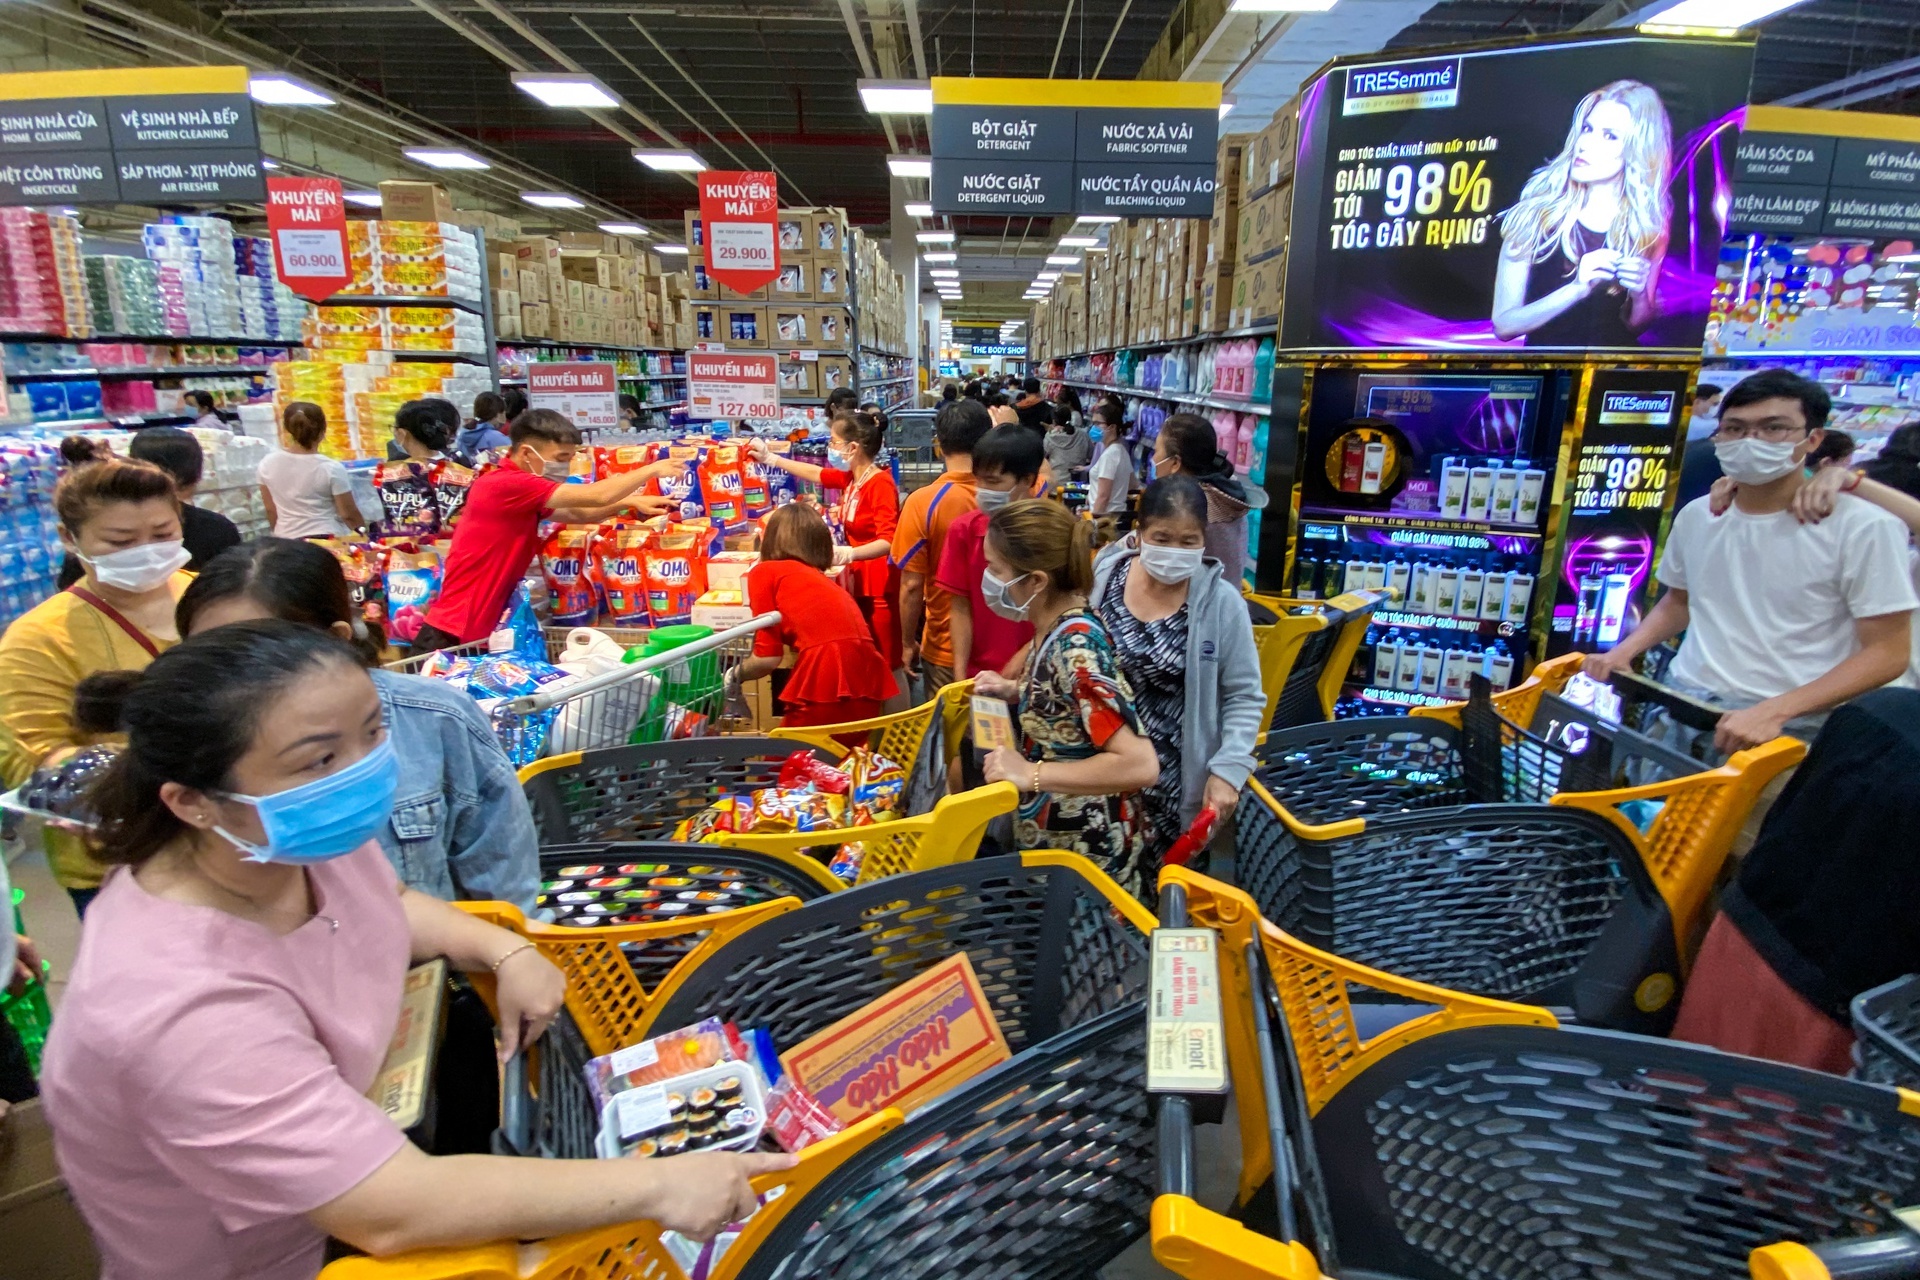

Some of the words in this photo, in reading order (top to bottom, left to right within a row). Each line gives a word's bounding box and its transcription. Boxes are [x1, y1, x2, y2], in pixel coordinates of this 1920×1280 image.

[1353, 65, 1452, 93] TRESemmé
[2, 116, 34, 131] SINH
[35, 112, 67, 128] NHÀ
[121, 109, 140, 129] VỆ
[141, 111, 176, 126] SINH
[178, 109, 211, 125] NHÀ
[213, 107, 239, 124] BẾP
[3, 133, 31, 143] HOME
[35, 131, 82, 142] CLEANING
[137, 130, 178, 140] KITCHEN
[180, 129, 229, 139] CLEANING
[972, 119, 1001, 138] BỘT
[1003, 120, 1037, 139] GIẶT
[1102, 122, 1145, 139] NƯỚC
[1147, 122, 1166, 139] XẢ
[1169, 122, 1193, 140] VẢI
[977, 139, 1031, 150] DETERGENT
[1107, 143, 1139, 153] FABRIC
[1141, 143, 1188, 153] SOFTENER
[1339, 149, 1356, 162] CHO
[1358, 146, 1374, 160] TÓC
[1375, 142, 1398, 159] CHẮC
[1424, 142, 1443, 155] HƠN
[1466, 139, 1477, 152] 10
[1768, 146, 1794, 161] SÓC
[1795, 149, 1814, 162] DA
[23, 164, 54, 181] CÔN
[54, 163, 103, 179] TRÙNG
[145, 164, 183, 178] THƠM
[190, 165, 208, 180] XỊT
[211, 162, 257, 177] PHÒNG
[1747, 163, 1767, 173] SKIN
[1768, 164, 1791, 174] CARE
[1870, 170, 1915, 182] COSMETICS
[963, 173, 1005, 189] NƯỚC
[1008, 174, 1041, 192] GIẶT
[1081, 175, 1121, 191] NƯỚC
[1123, 173, 1149, 191] TẨY
[1193, 177, 1214, 193] ÁO
[1335, 163, 1382, 192] GIẢM
[161, 183, 177, 192] AIR
[179, 182, 220, 192] FRESHER
[706, 183, 770, 199] KHUYẾN
[1384, 160, 1492, 216] 98%
[271, 189, 336, 205] KHUYẾN
[958, 193, 1011, 203] DETERGENT
[1012, 194, 1045, 205] LIQUID
[1105, 196, 1154, 206] BLEACHING
[1156, 196, 1186, 207] LIQUID
[1734, 194, 1765, 212] KIỆN
[1795, 199, 1820, 214] ĐẸP
[291, 205, 321, 222] MÃI
[725, 201, 753, 215] MÃI
[1333, 193, 1363, 219] TỚI
[1870, 203, 1876, 216] &
[1748, 213, 1804, 224] ACCESSORIES
[1874, 220, 1880, 229] &
[1330, 219, 1371, 250] TÓC
[1376, 217, 1421, 247] GÃY
[290, 255, 336, 267] 60.900
[720, 248, 766, 260] 29.900
[329, 312, 363, 321] PREMI
[401, 312, 438, 322] PREMIER
[973, 346, 987, 354] THE
[988, 346, 1006, 354] BODY
[1007, 346, 1026, 354] SHOP
[694, 361, 740, 376] KHUYẾN
[744, 363, 766, 377] MÃI
[532, 371, 578, 386] KHUYẾN
[581, 372, 603, 386] MÃI
[1402, 391, 1432, 404] 98%
[1607, 396, 1669, 411] TRESemmé
[718, 403, 776, 417] 127.900
[589, 416, 615, 424] 145.000
[1579, 455, 1608, 472] GIẢM
[722, 473, 741, 488] OM
[1577, 472, 1595, 488] TỚI
[1606, 457, 1667, 489] 98%
[383, 488, 423, 507] owny
[1574, 488, 1599, 507] TÓC
[1600, 488, 1627, 507] GÃY
[1454, 534, 1468, 548] TỚI
[1469, 537, 1489, 549] 98%
[554, 559, 580, 576] OMO
[661, 560, 690, 576] OMO
[388, 584, 423, 600] owny
[1373, 611, 1388, 622] CHO
[1363, 688, 1379, 699] CHO
[1188, 1028, 1207, 1070] emart
